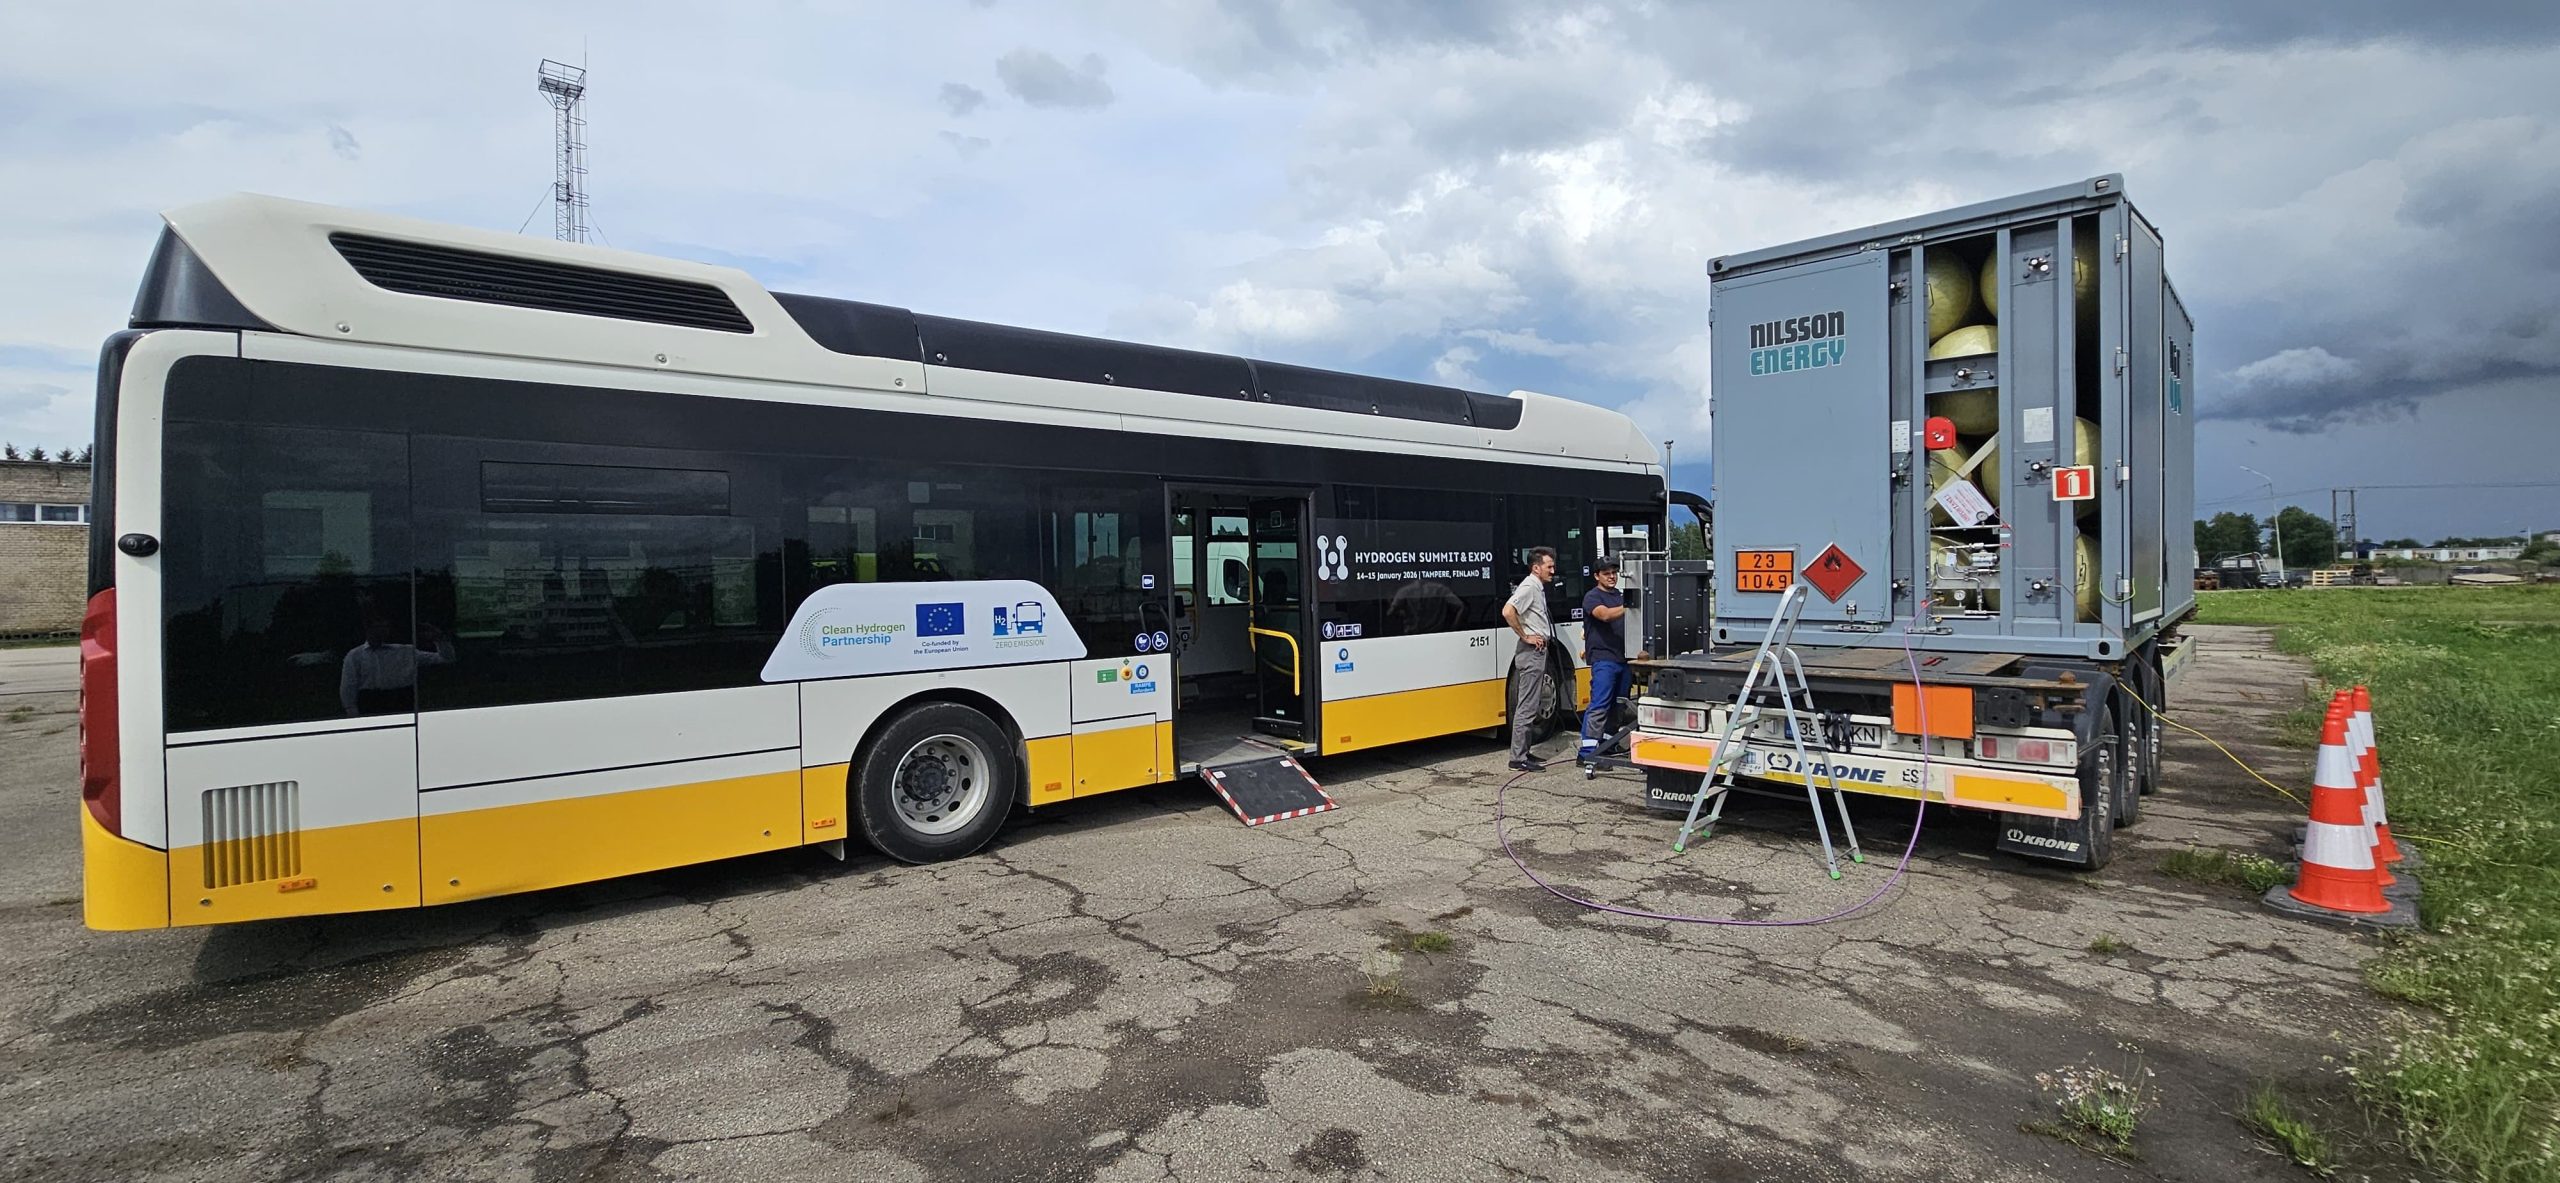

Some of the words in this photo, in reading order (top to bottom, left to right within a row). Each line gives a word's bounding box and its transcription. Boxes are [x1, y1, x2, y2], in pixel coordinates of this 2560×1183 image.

[1749, 310, 1845, 349] NILSSON
[1750, 338, 1846, 376] ENERGY
[1355, 552, 1416, 563] HYDROGEN
[1753, 553, 1775, 569] 23
[1377, 572, 1402, 581] January
[1403, 571, 1418, 579] 2026
[1422, 570, 1452, 579] TAMPERE,
[1452, 569, 1480, 578] FINLAND
[1741, 574, 1787, 589] 1049
[822, 625, 853, 635] Clean
[856, 623, 906, 635] Hydrogen
[822, 633, 892, 647] Partnership
[995, 641, 1013, 649] ZERO
[1013, 639, 1045, 648] EMISSION
[1470, 636, 1489, 647] 2151
[1795, 760, 1887, 784] KRONE
[1902, 768, 1928, 784] ES
[1662, 792, 1695, 803] KRON
[2022, 835, 2080, 853] KRONE
